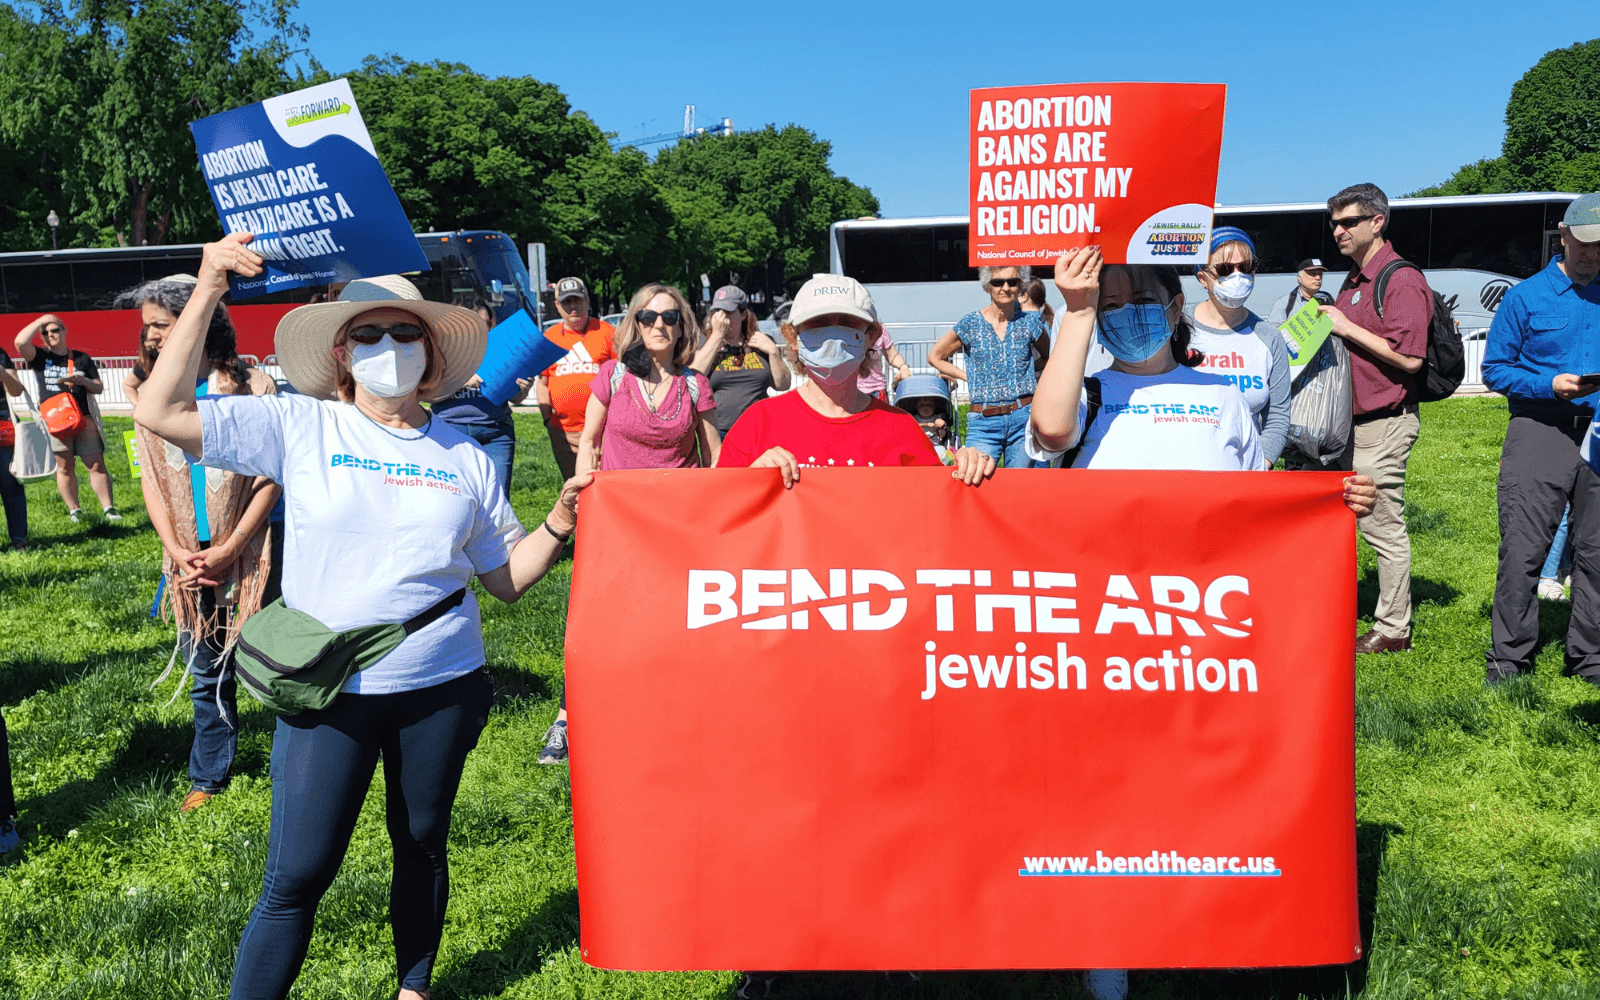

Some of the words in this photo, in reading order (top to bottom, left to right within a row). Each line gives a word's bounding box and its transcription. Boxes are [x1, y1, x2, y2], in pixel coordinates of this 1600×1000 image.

[977, 95, 1111, 131] ABORTION
[202, 140, 270, 180] ABORTION
[978, 134, 1047, 167] BANS
[1053, 131, 1106, 163] ARE
[213, 183, 235, 210] IS
[977, 168, 1087, 202] AGAINST
[1094, 167, 1133, 198] MY
[313, 195, 337, 222] IS
[335, 192, 354, 219] A
[977, 203, 1101, 236] RELIGION.
[281, 228, 345, 260] RIGHT.
[1149, 233, 1205, 243] ABORTION
[1154, 244, 1198, 253] JUSTICE
[977, 250, 1006, 259] National
[1008, 249, 1035, 258] Council
[1037, 249, 1045, 257] of
[238, 279, 270, 290] National
[814, 286, 850, 296] DREW
[555, 361, 600, 377] adidas
[1187, 350, 1245, 369] orah
[1104, 404, 1149, 414] BEND
[1150, 404, 1186, 414] THE
[1189, 404, 1220, 417] ARC
[1153, 415, 1189, 424] jewish
[331, 454, 381, 471] BEND
[383, 462, 421, 476] THE
[424, 468, 459, 485] ARC
[384, 474, 423, 487] jewish
[426, 480, 462, 494] action
[687, 569, 908, 631] BEND
[916, 569, 1081, 635] THE
[1095, 574, 1254, 639] ARC
[921, 640, 1087, 700] jewish
[1102, 645, 1259, 693] action
[1022, 850, 1276, 874] www.bendthearc.us
